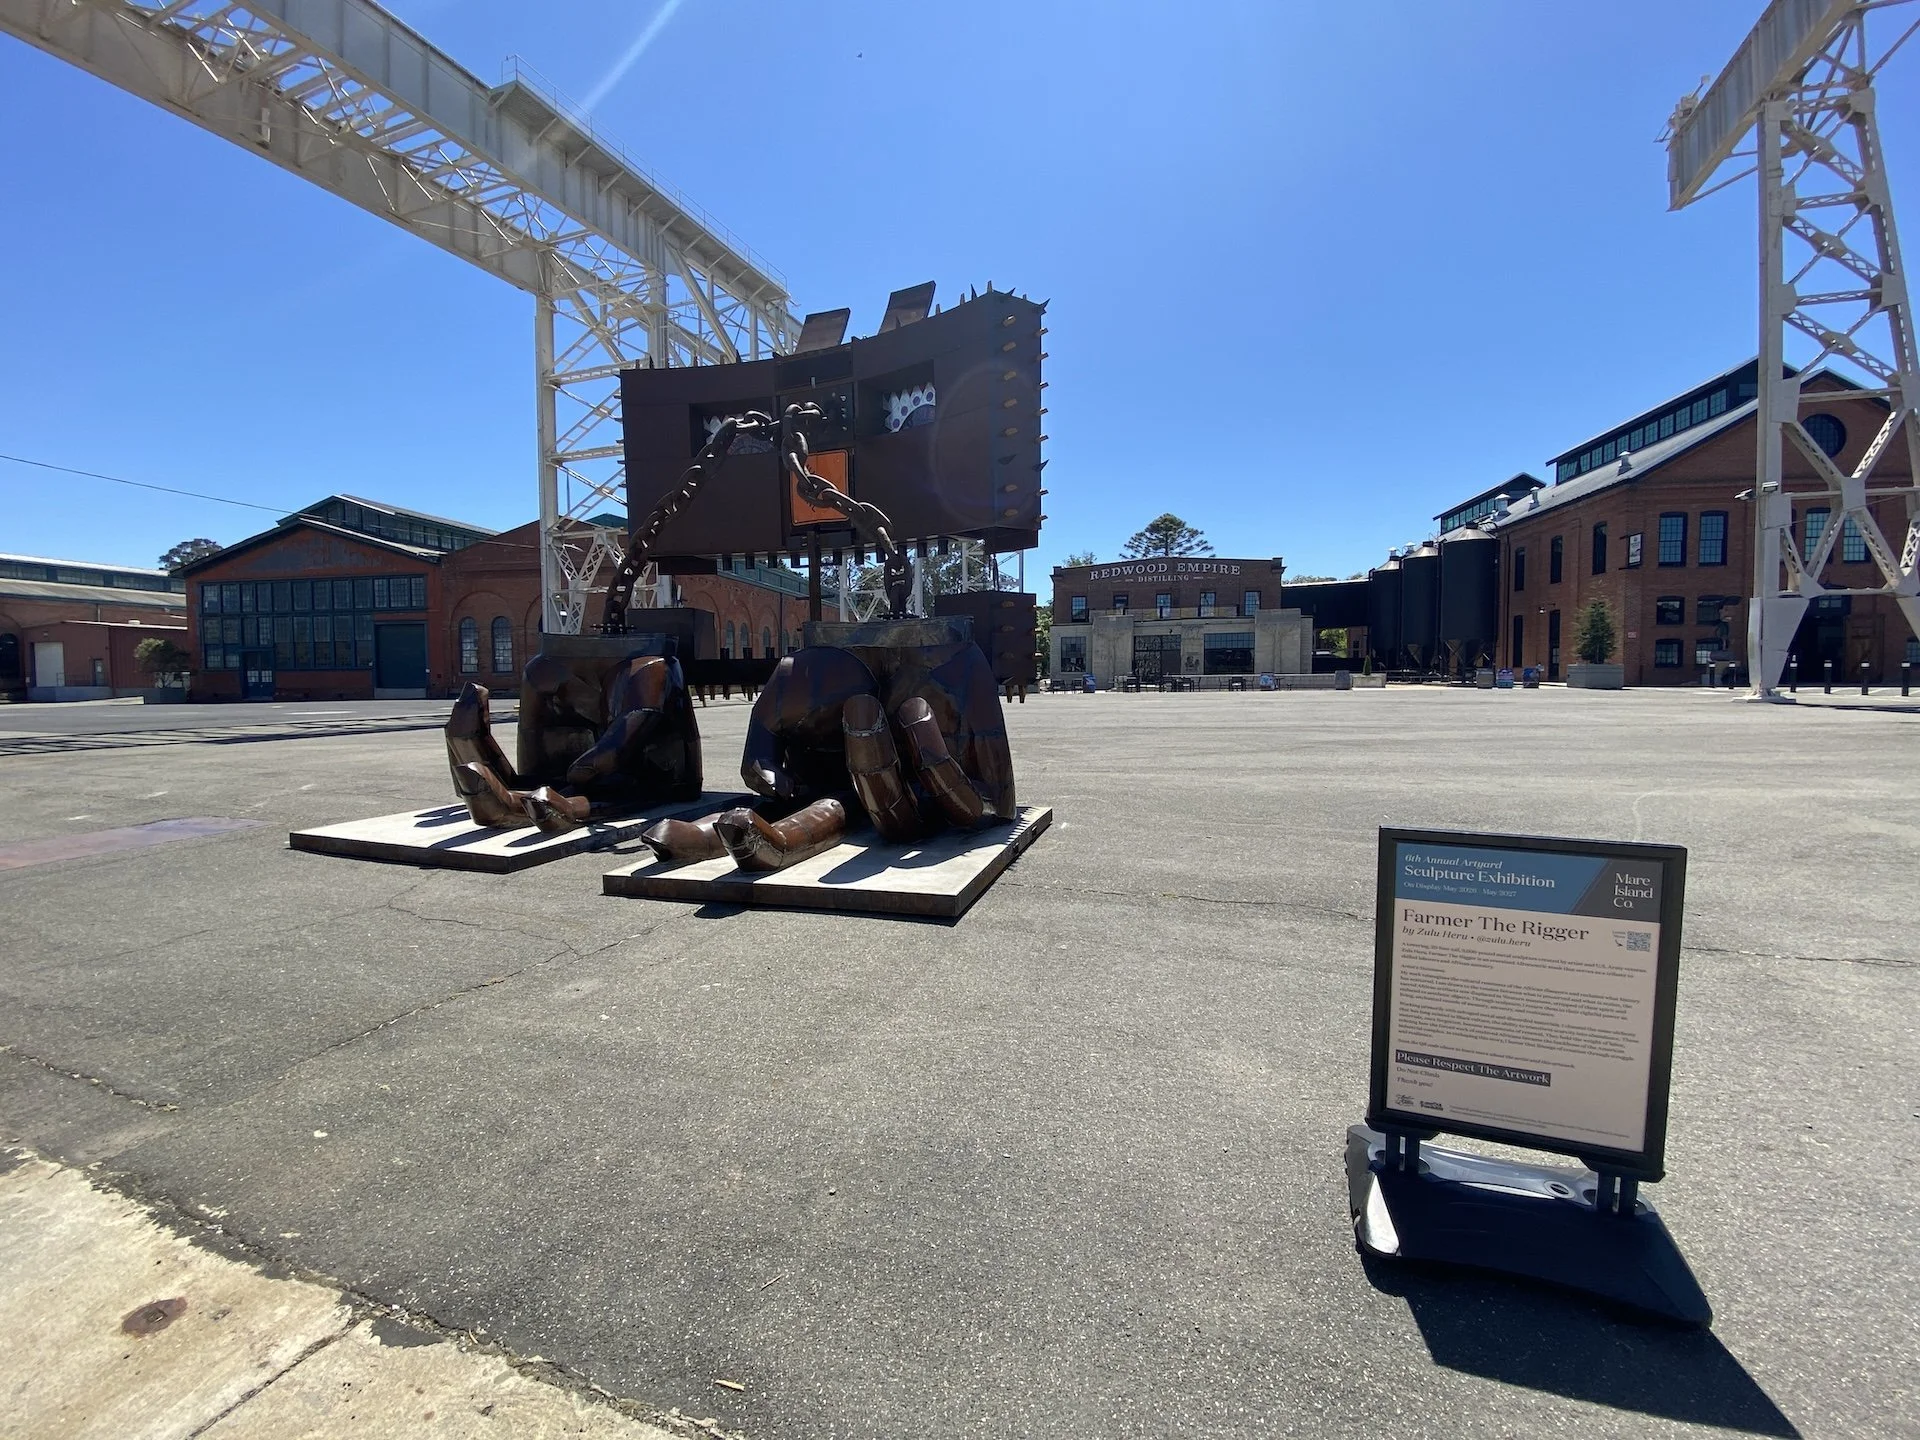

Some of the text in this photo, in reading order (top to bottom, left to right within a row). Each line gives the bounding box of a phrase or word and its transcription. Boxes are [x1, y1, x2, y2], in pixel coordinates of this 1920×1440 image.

[1090, 563, 1241, 580] REDWOOD EMPIRE
[1405, 854, 1502, 870] 6th Annual Artyard
[1404, 865, 1555, 888] Sculpture Exhibition
[1615, 873, 1650, 886] Mare
[1614, 885, 1653, 898] Island
[1404, 909, 1589, 942] Farmer The Rigger
[1402, 926, 1531, 947] by Zulu Heru @zulu.heru
[1397, 1052, 1430, 1064] Please
[1433, 1058, 1474, 1073] Respect
[1477, 1065, 1499, 1075] The
[1502, 1069, 1548, 1083] Artwork
